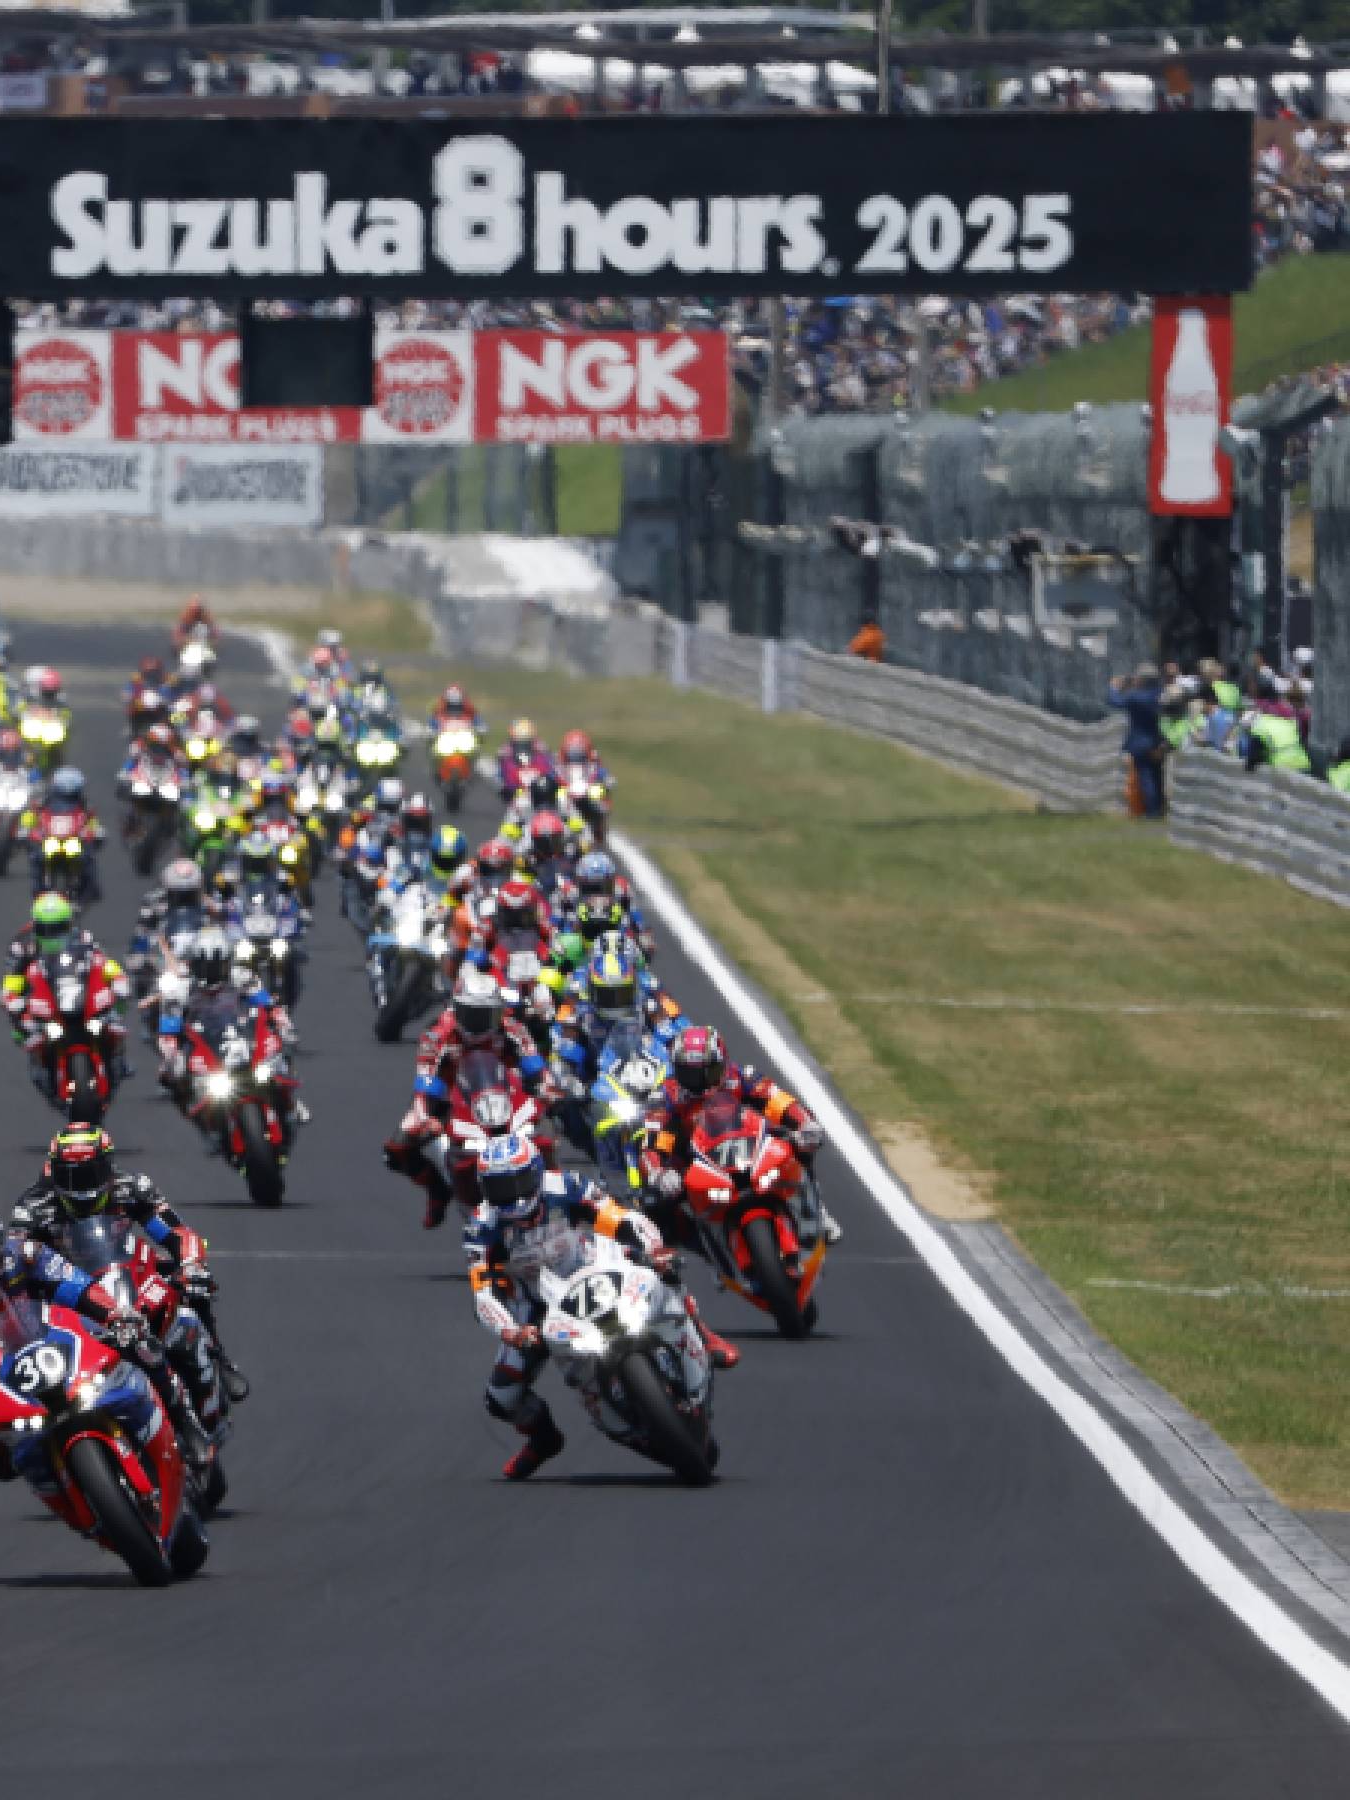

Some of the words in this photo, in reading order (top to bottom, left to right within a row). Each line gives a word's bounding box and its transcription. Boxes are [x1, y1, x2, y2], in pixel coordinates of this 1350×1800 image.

[51, 170, 425, 276] Suzuka
[433, 134, 526, 275] 8
[855, 194, 1074, 273] 2025
[137, 337, 242, 408] NG
[499, 338, 698, 409] NGK
[13, 1346, 67, 1394] 30
